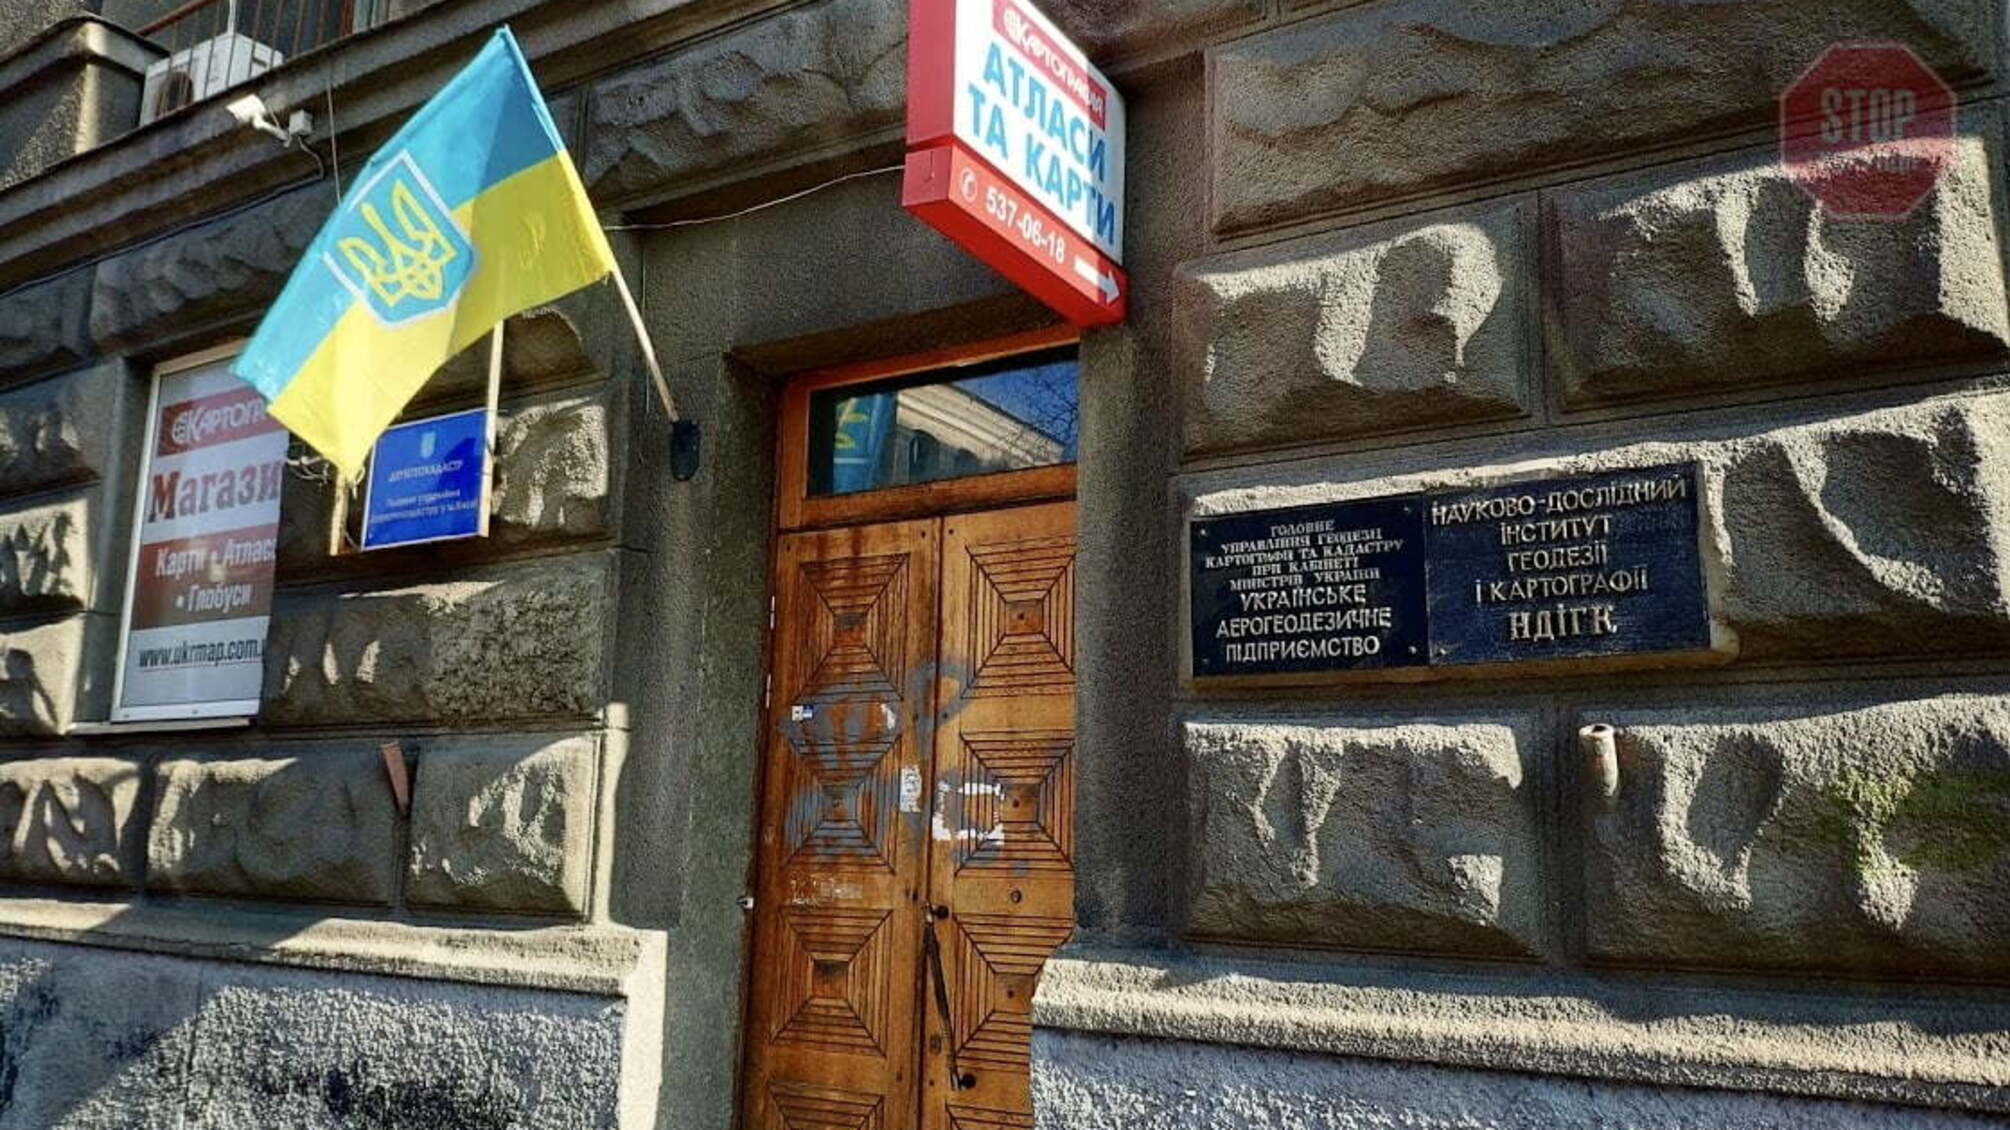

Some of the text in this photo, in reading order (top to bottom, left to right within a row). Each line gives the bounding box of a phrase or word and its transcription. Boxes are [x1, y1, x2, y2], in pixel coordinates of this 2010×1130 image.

[983, 42, 1106, 182] АТЛАСИ
[968, 83, 1115, 245] ТА КАРТИ
[985, 186, 1065, 264] 537-06-18
[1431, 474, 1688, 526] НАУКОВО-ДОСЛІДНИЙ
[1271, 520, 1335, 537] ГОЛОВНЕ
[1500, 514, 1613, 546] ІНСТИТУТ
[1221, 535, 1310, 555] УПРАВЛІННЯ
[1301, 547, 1318, 560] ТА
[1323, 539, 1404, 558] КАДАСТРУ
[1508, 539, 1607, 572] ГЕОДЕЗІЇ
[1229, 567, 1380, 592] МІНІСТРІВ УКРАЇНИ
[1252, 557, 1359, 577] ПРИ КАБІНЕТІ
[1490, 564, 1648, 601] КАРТОГРАФІЇ
[188, 582, 251, 614] Глобуси
[1240, 583, 1367, 612] УКРАЇНСЬКЕ
[1216, 607, 1392, 639] АЕРОГЕОДЕЗИЧНЕ
[1509, 603, 1617, 642] НДІГК
[1226, 635, 1380, 664] ПІДПРИЄМСТВО
